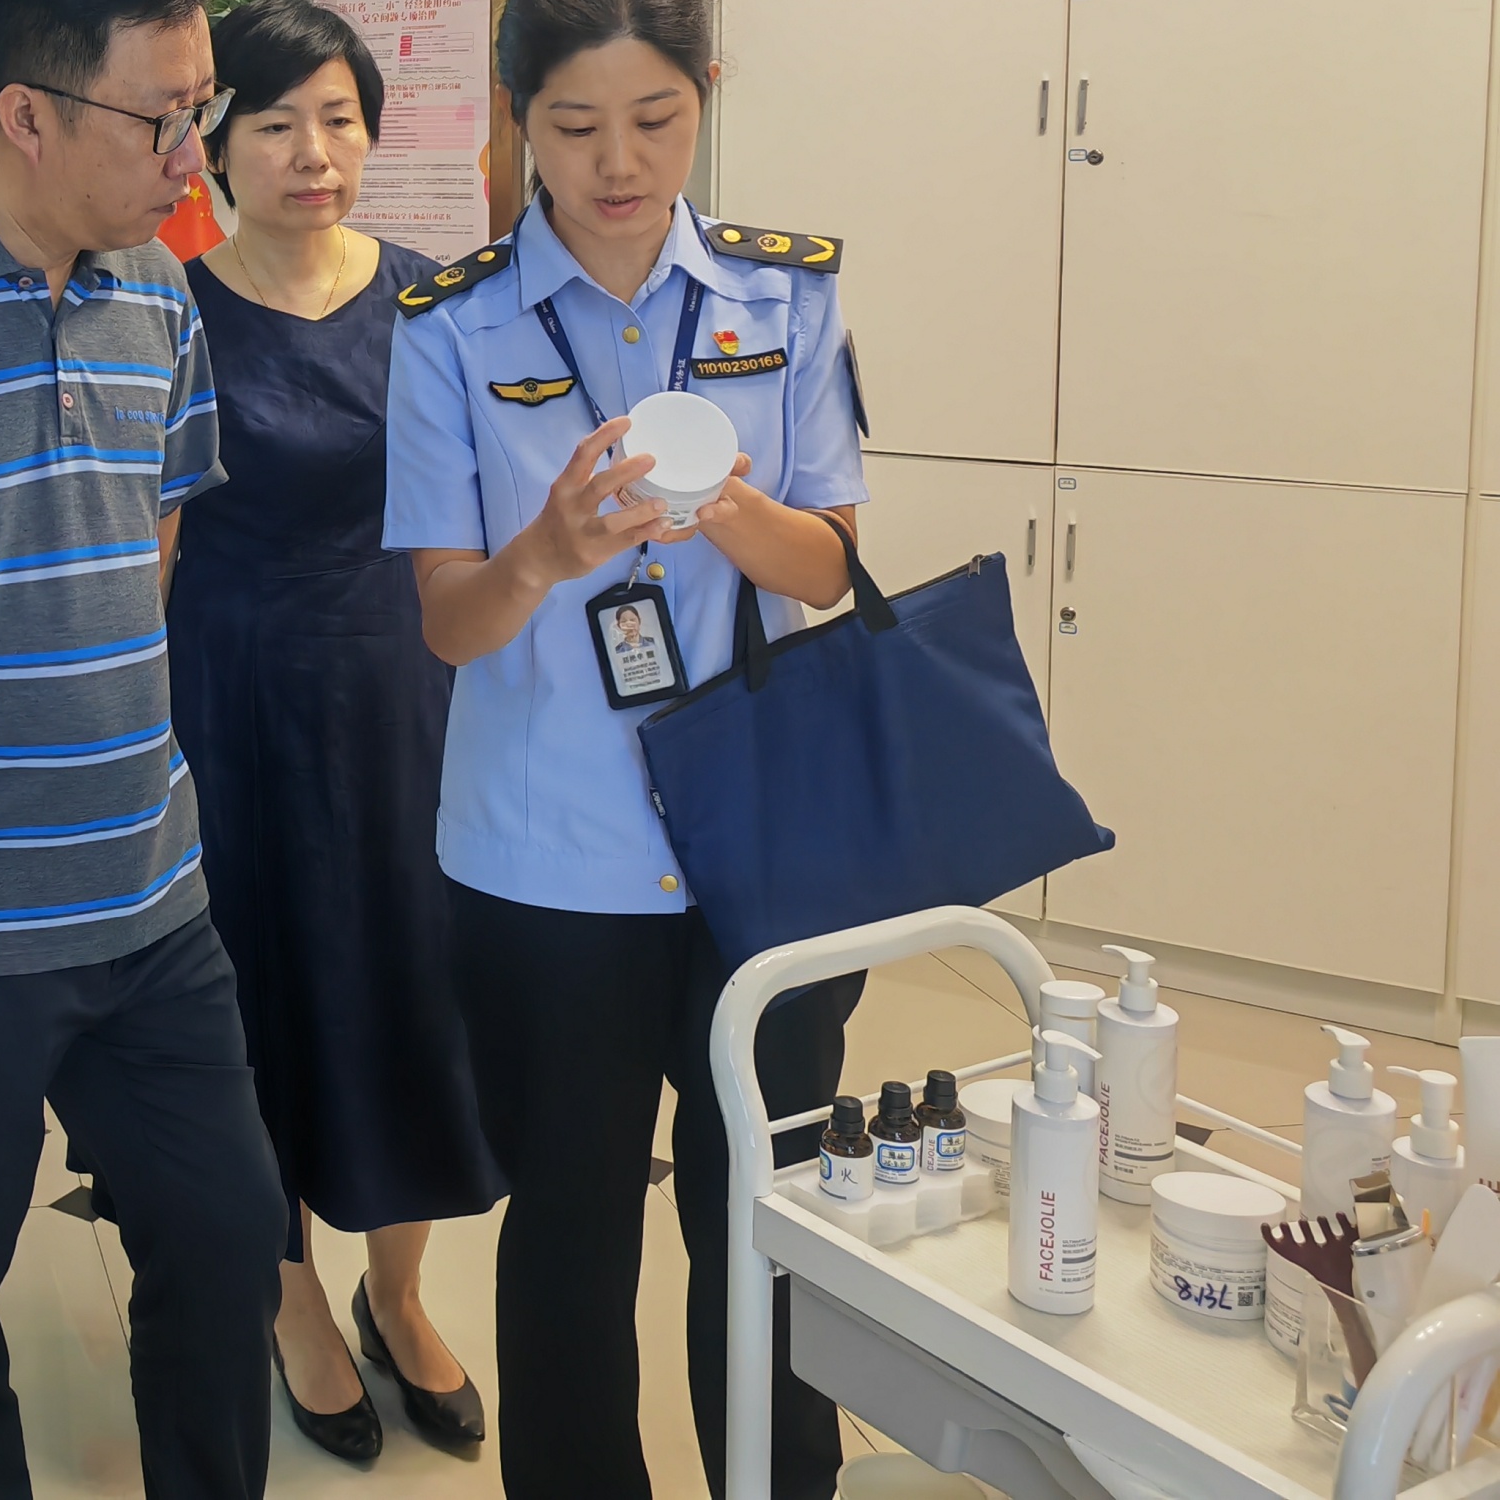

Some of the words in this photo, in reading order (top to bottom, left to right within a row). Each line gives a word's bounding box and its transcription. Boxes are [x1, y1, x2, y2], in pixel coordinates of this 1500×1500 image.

[697, 353, 783, 374] 11010230168
[1099, 1081, 1111, 1168] FACEJOLIE
[1039, 1190, 1056, 1282] FACEJOLIE
